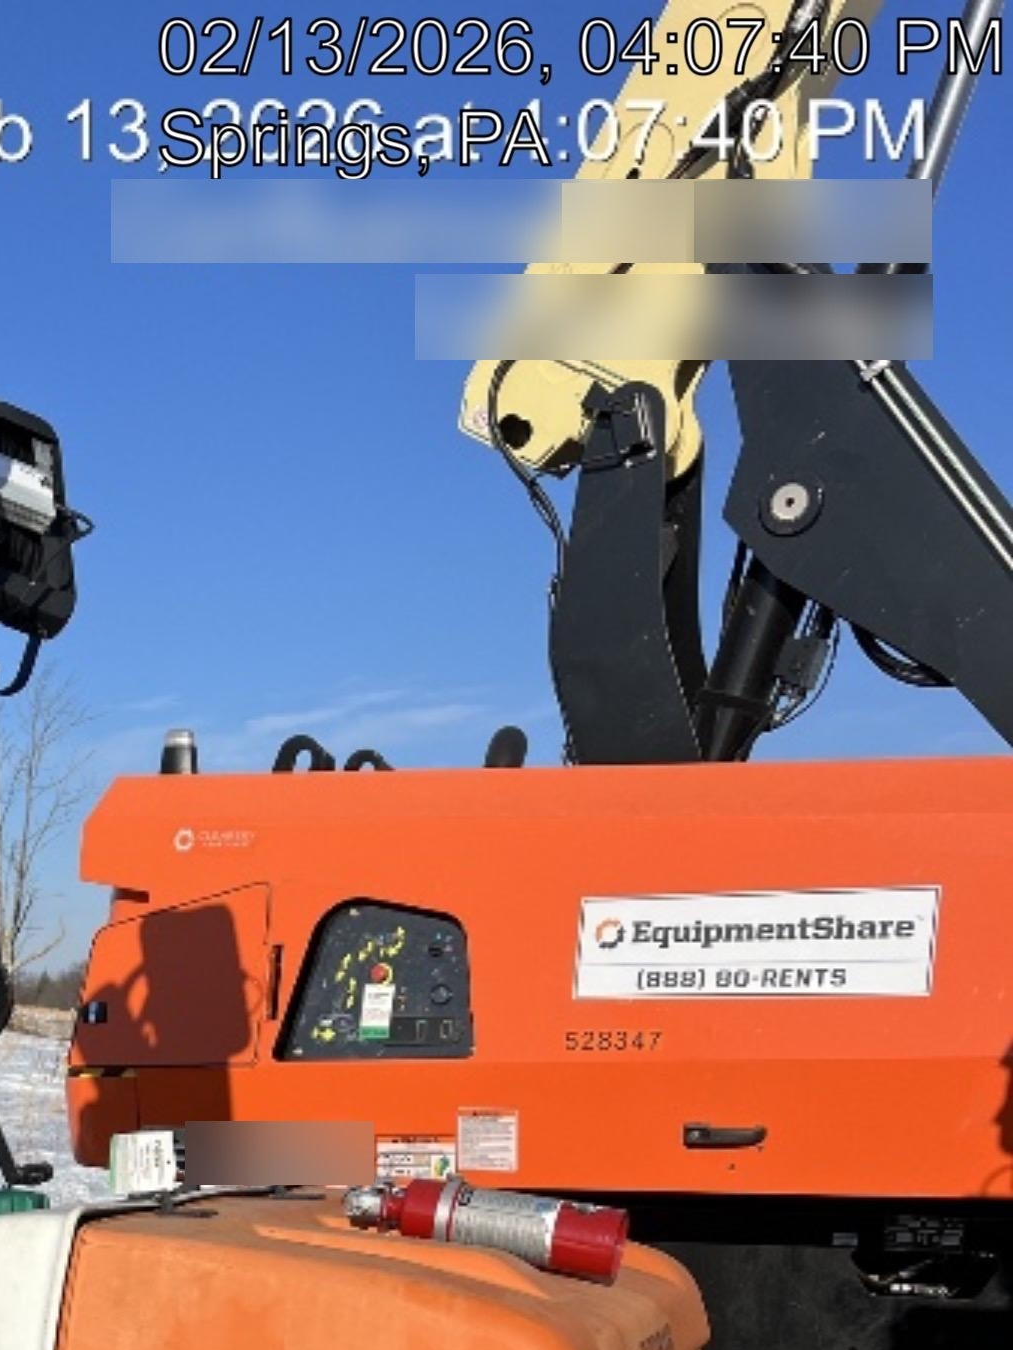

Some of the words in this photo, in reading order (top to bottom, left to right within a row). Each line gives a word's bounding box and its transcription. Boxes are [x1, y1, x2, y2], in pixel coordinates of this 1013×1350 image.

[631, 915, 916, 949] EquipmentShare
[637, 967, 706, 990] (888)
[564, 1030, 663, 1052] 528347
